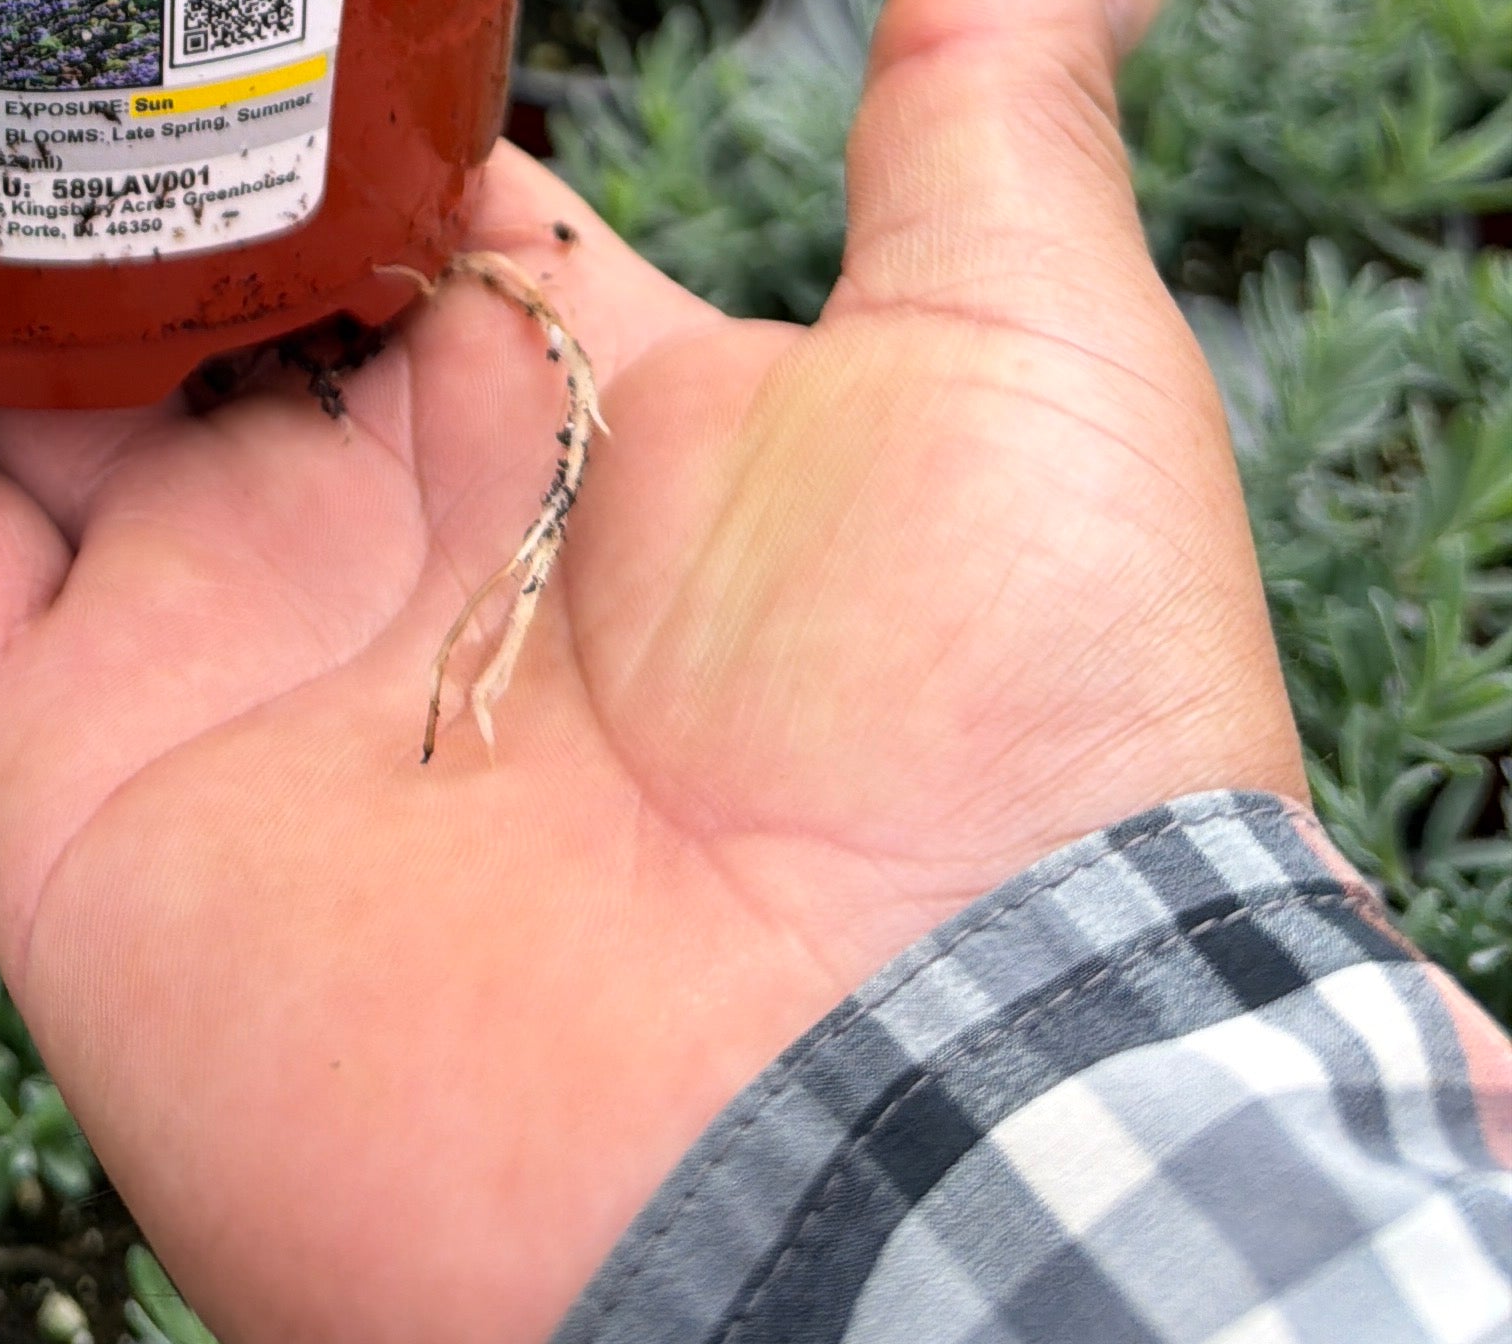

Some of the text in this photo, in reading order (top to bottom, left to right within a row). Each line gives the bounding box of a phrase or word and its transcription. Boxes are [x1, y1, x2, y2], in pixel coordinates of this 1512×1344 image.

[4, 97, 174, 116] EXPOSURE: Sun
[5, 127, 105, 144] BLOOMS:
[112, 126, 156, 142] Late
[237, 92, 314, 123] Summer
[53, 164, 210, 199] 589LAV001
[8, 221, 67, 240] Porte,
[106, 217, 163, 236] 46350
